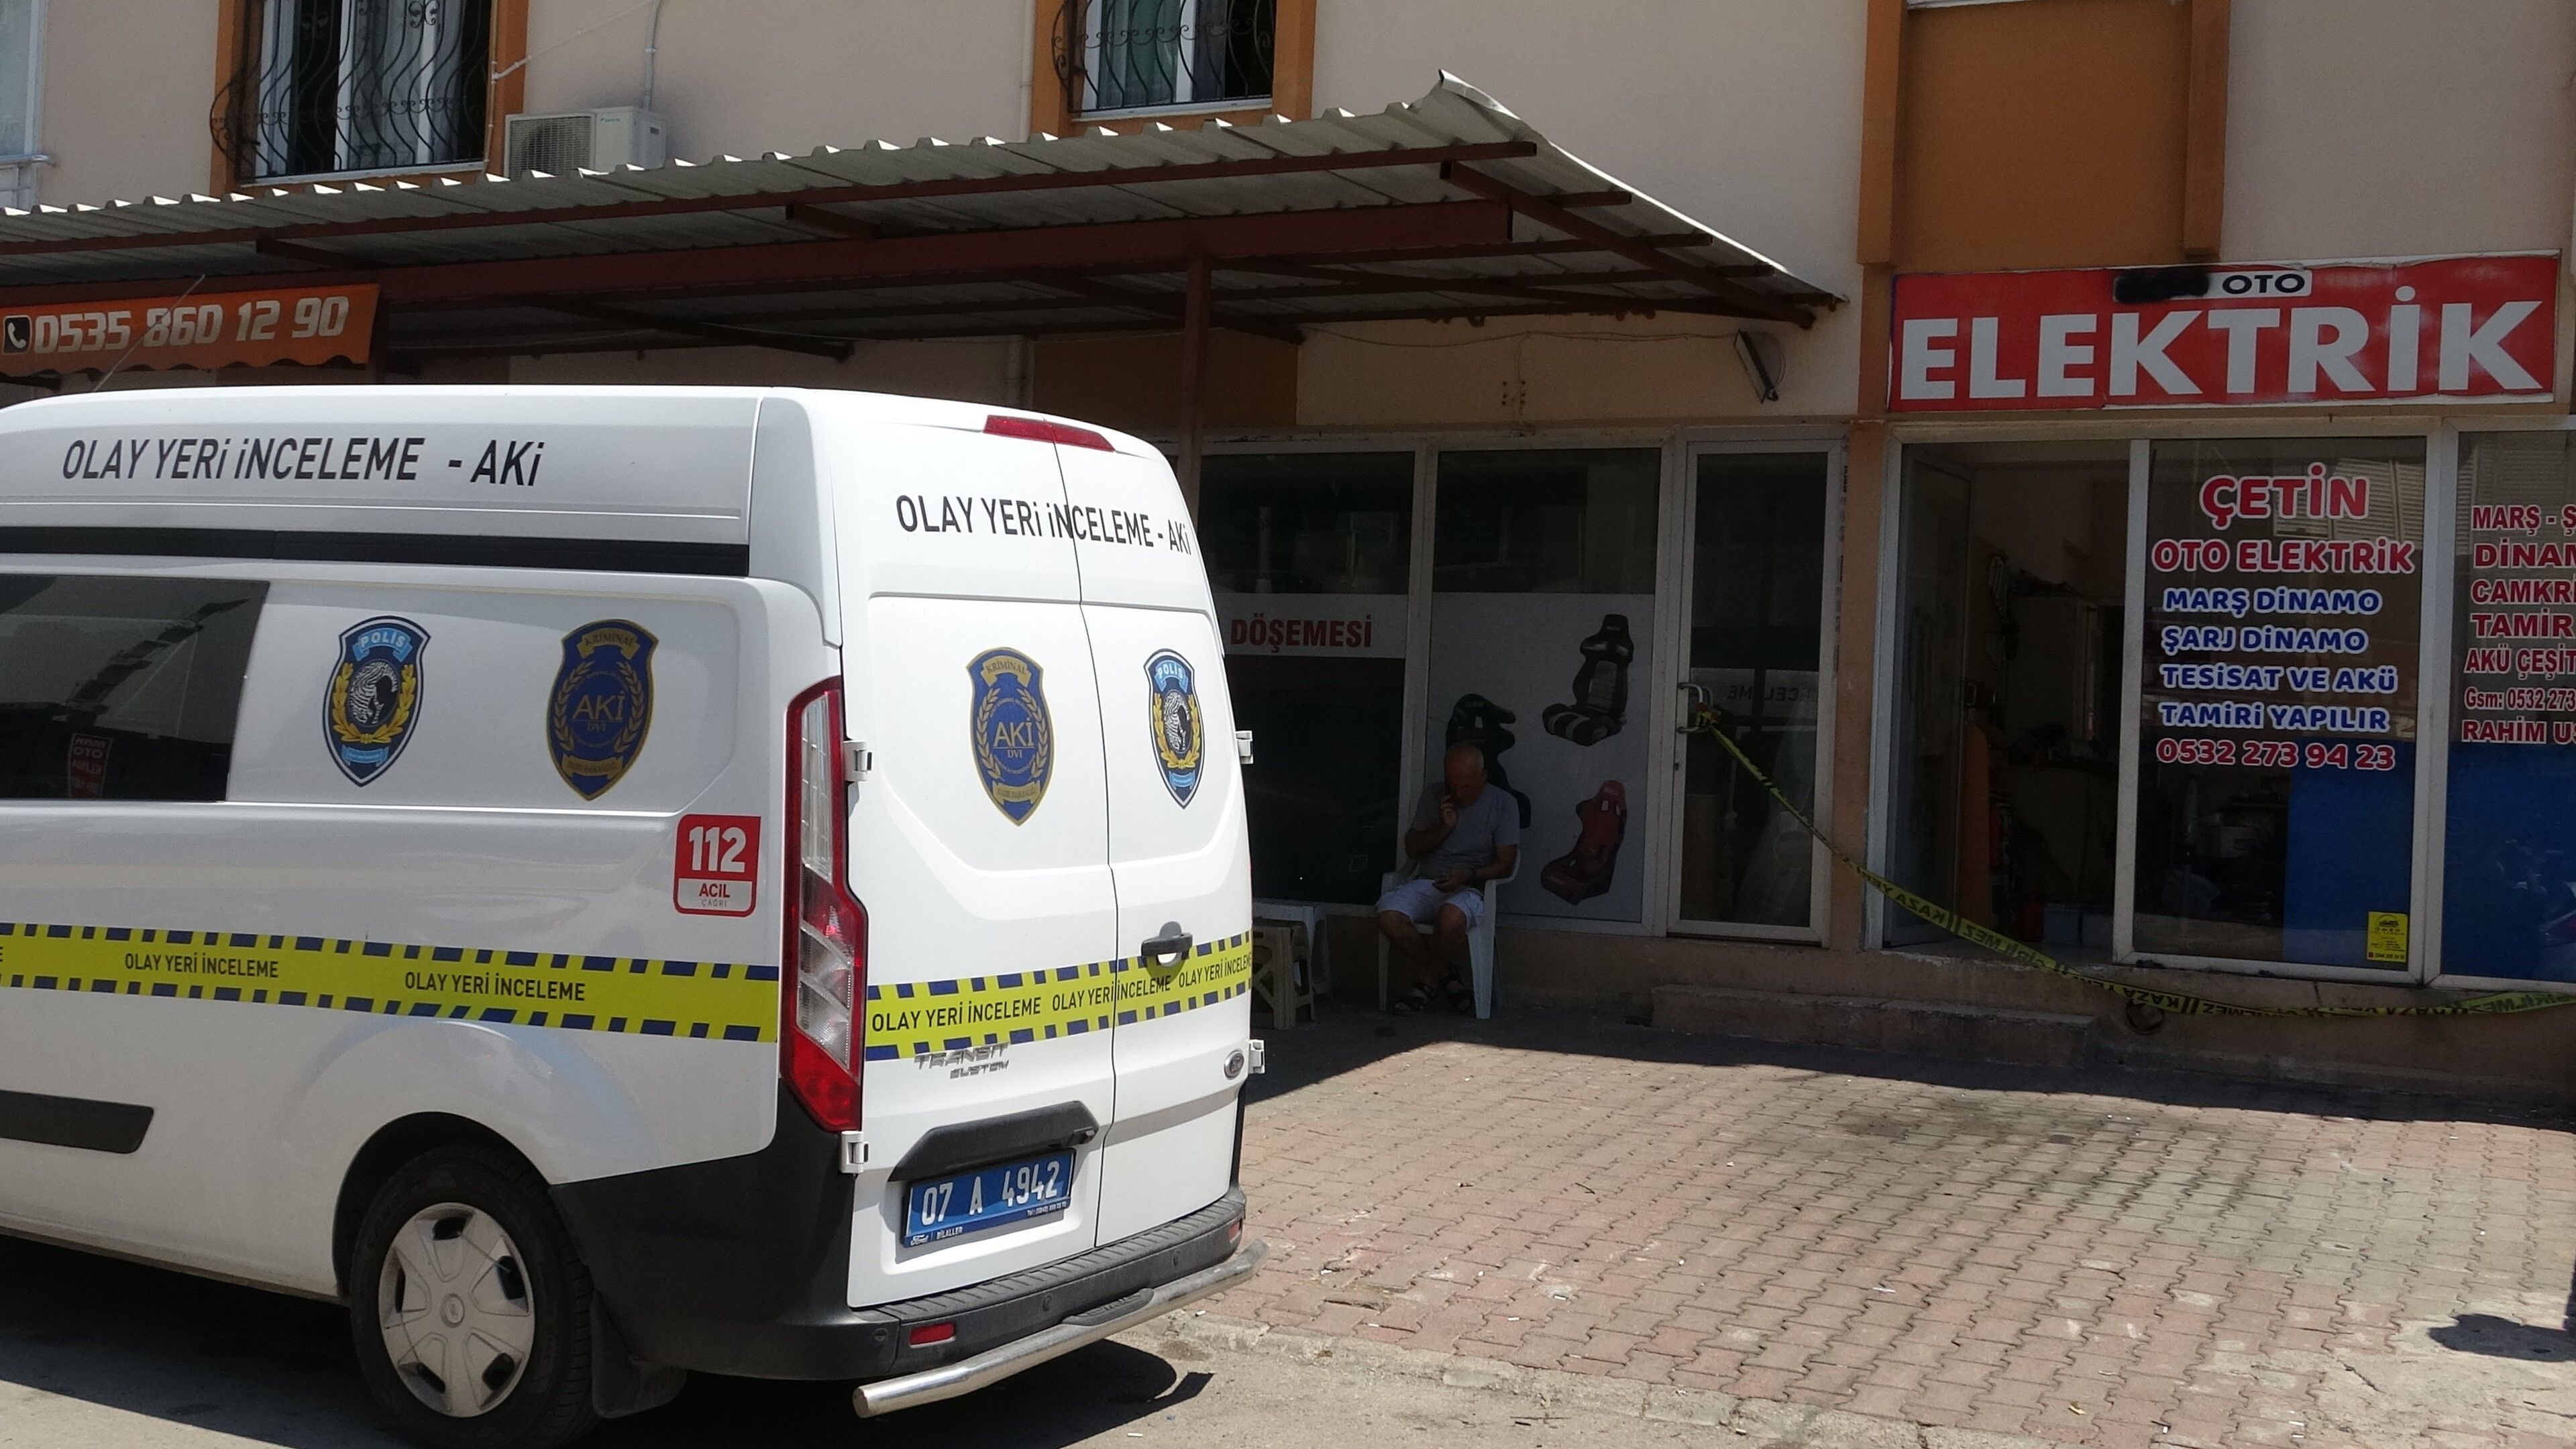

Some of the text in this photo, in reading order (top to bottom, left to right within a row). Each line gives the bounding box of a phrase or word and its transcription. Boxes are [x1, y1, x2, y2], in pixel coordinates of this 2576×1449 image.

[2222, 274, 2305, 294] OTO
[34, 296, 350, 354] 0535 860 12 90
[1899, 284, 2544, 400] ELEKTRİK
[63, 439, 150, 479] OLAY
[2200, 462, 2369, 529] ÇETİN
[896, 494, 973, 533] OLAY
[2472, 504, 2541, 536] MARŞ
[2152, 538, 2230, 572] OTO
[2163, 588, 2249, 618] MARŞ
[2471, 575, 2576, 604] CAMKR
[1230, 612, 1372, 653] DÖŞEMESİ
[2161, 625, 2236, 655] ŞARJ
[2464, 643, 2512, 674] AKÜ
[2288, 665, 2329, 692] VE
[2332, 665, 2398, 694] AKÜ
[2465, 686, 2576, 711] Gsm: 0532 273
[994, 717, 1035, 748] AKİ
[2268, 704, 2390, 733] YAPILIR
[1007, 749, 1023, 759] DVI
[2156, 738, 2395, 771] 0532 273 94 23
[689, 826, 746, 873] 112
[125, 952, 279, 978] OLAY YERİ İNCELEME
[1179, 968, 1202, 988] OLAY
[1204, 959, 1224, 982] YERİ
[405, 972, 585, 1001] OLAY YERİ İNCELEME
[1053, 975, 1171, 1011] OLAY YERİ İNCELEME
[872, 997, 1041, 1032] OLAY YERİ İNCELEME
[914, 1042, 1011, 1069] TRANSIT
[949, 1060, 1010, 1079] CUSTOM
[922, 1161, 1059, 1226] 07 A 4942
